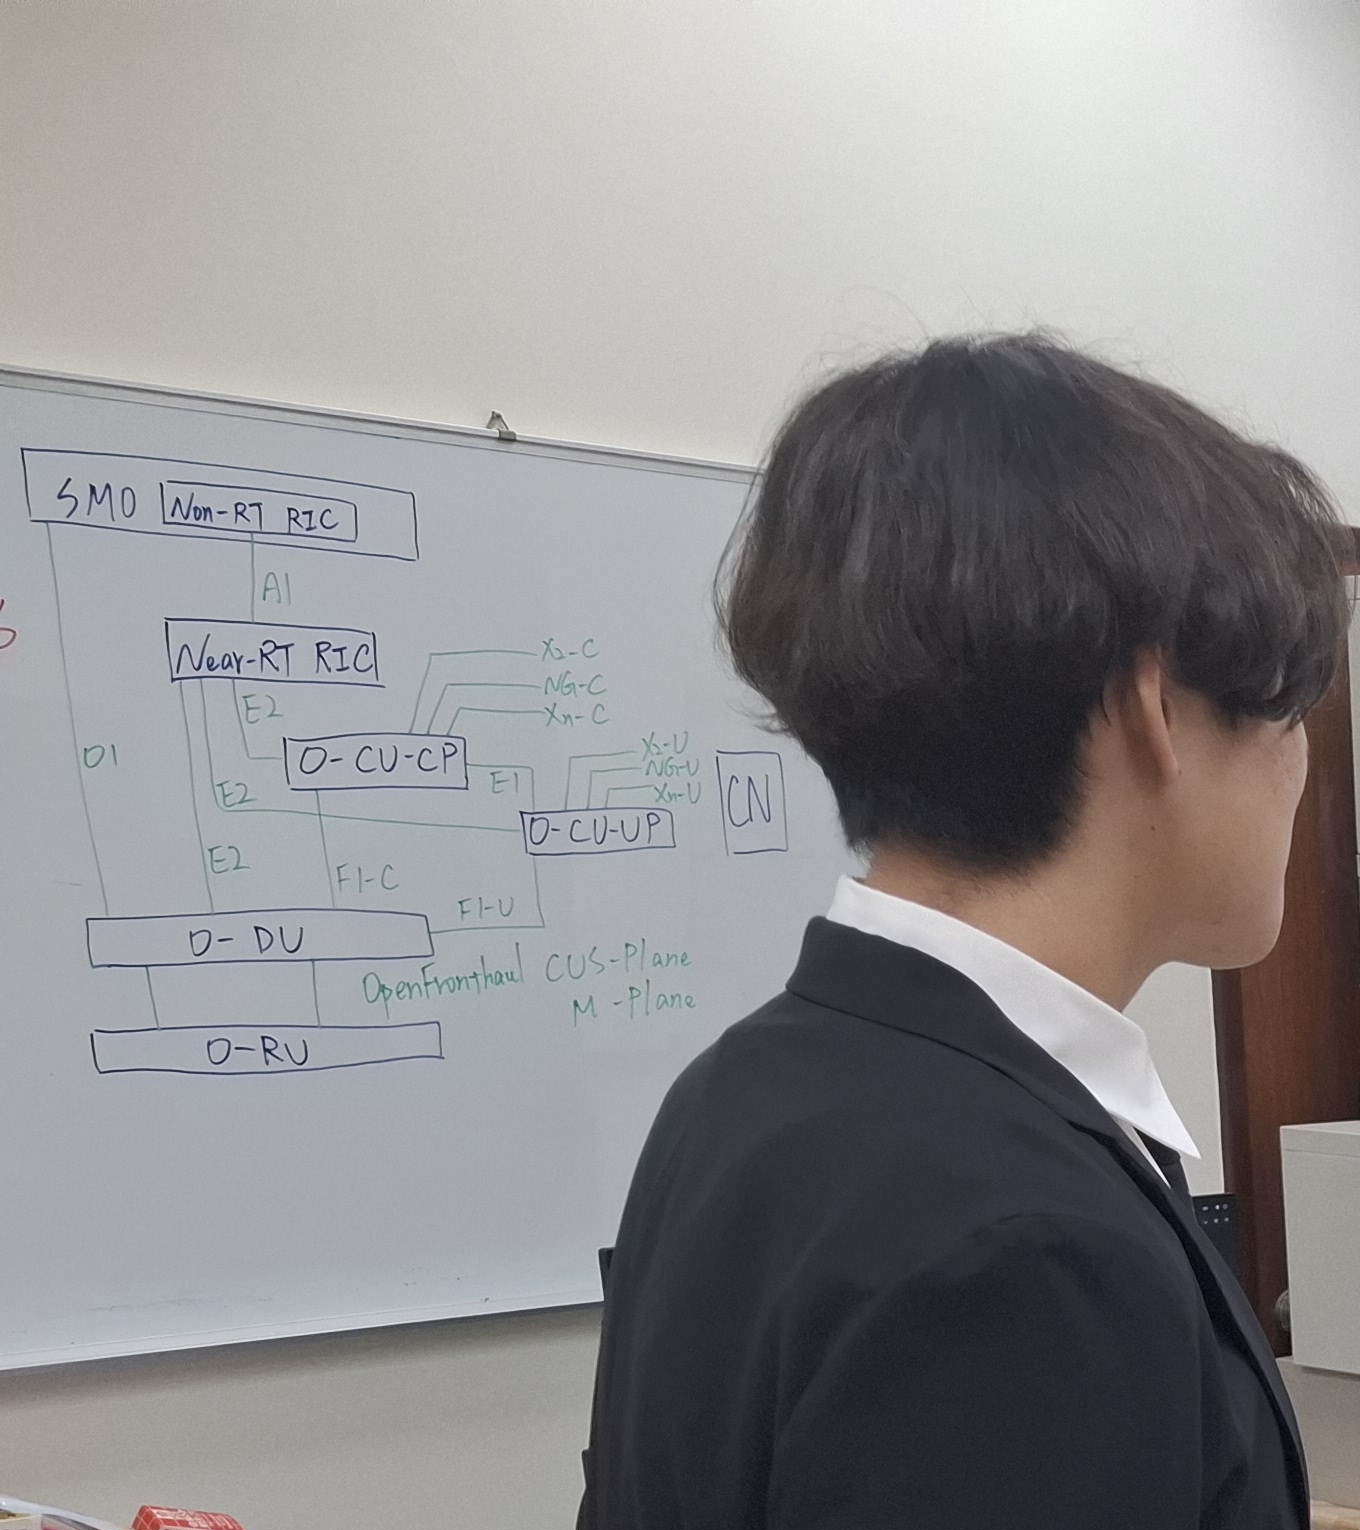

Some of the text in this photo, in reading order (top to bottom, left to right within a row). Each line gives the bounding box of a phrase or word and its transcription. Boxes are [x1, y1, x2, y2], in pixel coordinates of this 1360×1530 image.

[57, 477, 137, 522] SMO
[171, 492, 339, 534] Non-RT RIC
[176, 634, 374, 677] Near-RT RIC
[242, 694, 283, 724] E2
[216, 780, 257, 807] E2
[728, 774, 771, 827] CN
[207, 845, 250, 874] E2
